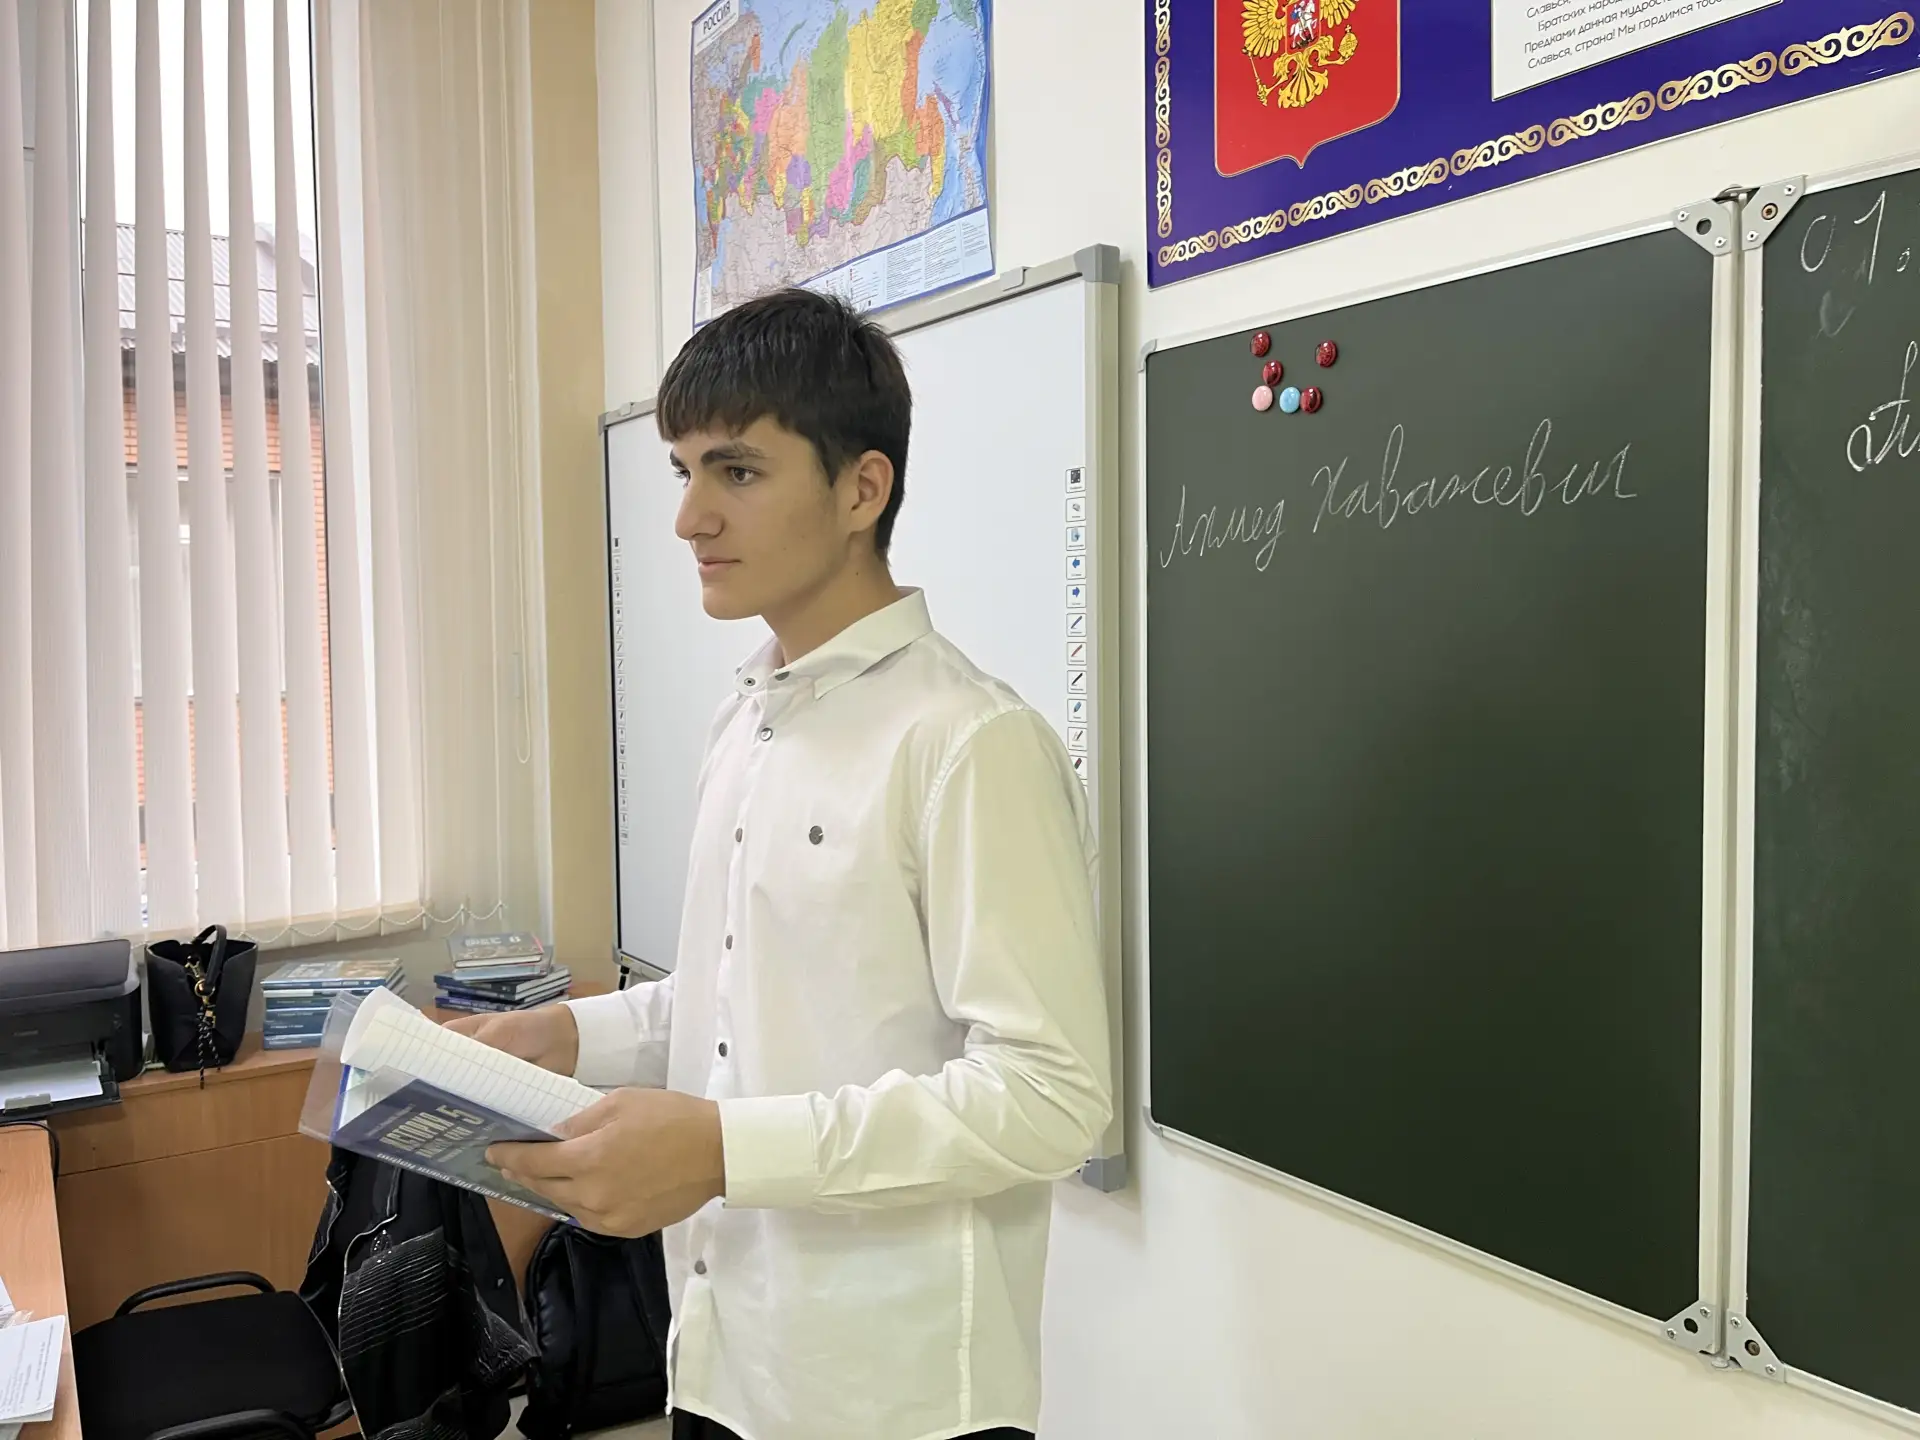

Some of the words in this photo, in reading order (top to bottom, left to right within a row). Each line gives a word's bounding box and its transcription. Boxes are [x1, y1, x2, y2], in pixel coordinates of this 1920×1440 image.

[1524, 28, 1576, 54] Предками
[1577, 12, 1618, 35] данная
[1527, 47, 1572, 69] Славься,
[1574, 29, 1615, 52] страна!
[1617, 24, 1636, 37] Мы
[1638, 4, 1694, 30] гордимся
[1538, 7, 1587, 31] Братских
[379, 1111, 456, 1152] ИСТОРИЯ
[435, 1104, 485, 1126] 5
